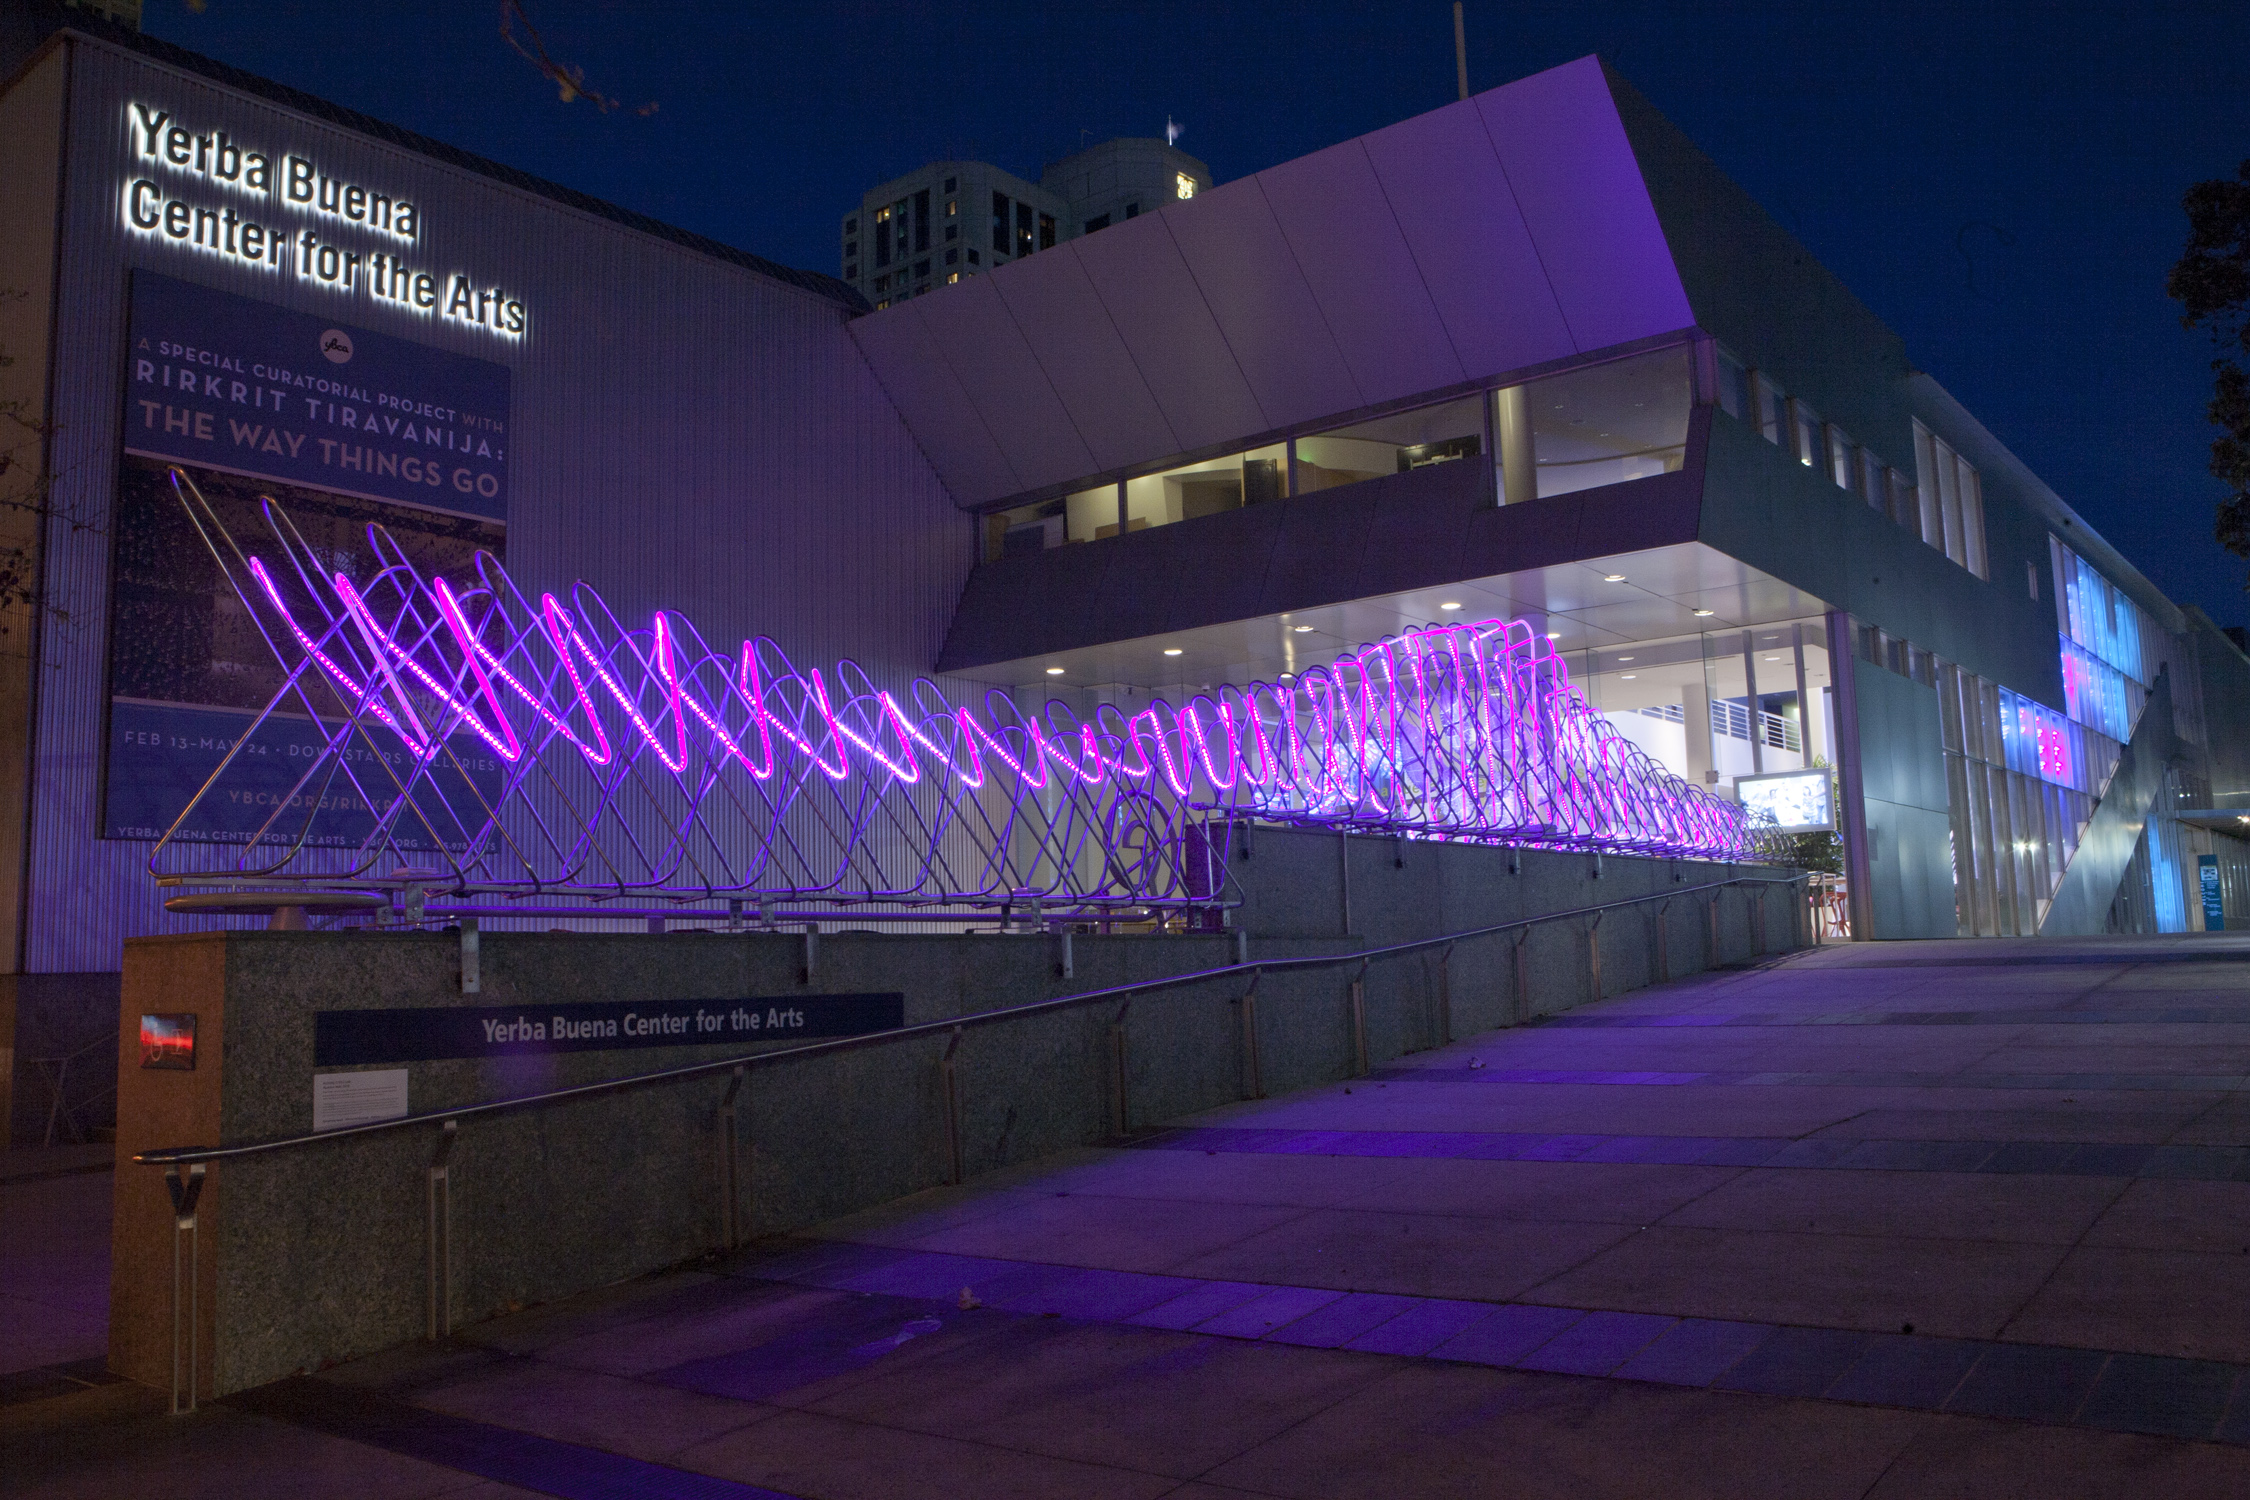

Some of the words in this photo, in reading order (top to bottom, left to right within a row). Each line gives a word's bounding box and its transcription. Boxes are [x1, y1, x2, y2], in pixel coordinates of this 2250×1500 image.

[132, 102, 270, 193] Yerba
[285, 154, 418, 240] Buena
[129, 178, 287, 267] Center
[299, 230, 360, 288] for
[370, 253, 436, 309] the
[444, 275, 526, 334] Arts
[138, 337, 150, 351] A
[159, 341, 245, 374] SPECIAL
[253, 363, 371, 403] CURATORIAL
[378, 392, 456, 423] PROJECT
[462, 412, 504, 434] WITH
[324, 337, 349, 353] ybca
[136, 358, 286, 412] RIRKRIT
[305, 397, 503, 461] TIRAVANIJA:
[138, 399, 214, 441] THE
[228, 418, 306, 459] WAY
[316, 437, 442, 488] THINGS
[452, 467, 500, 499] GO
[125, 731, 160, 746] FEB
[248, 744, 267, 755] 24
[118, 826, 160, 838] YERBA
[165, 828, 208, 840] UENA
[212, 831, 258, 842] CENTE
[264, 832, 288, 843] FOR
[317, 835, 346, 845] ARTS
[482, 1018, 547, 1042] Yerba
[552, 1014, 618, 1040] Buena
[623, 1011, 691, 1036] Center
[696, 1008, 727, 1032] for
[730, 1006, 762, 1030] the
[765, 1006, 806, 1028] Arts
